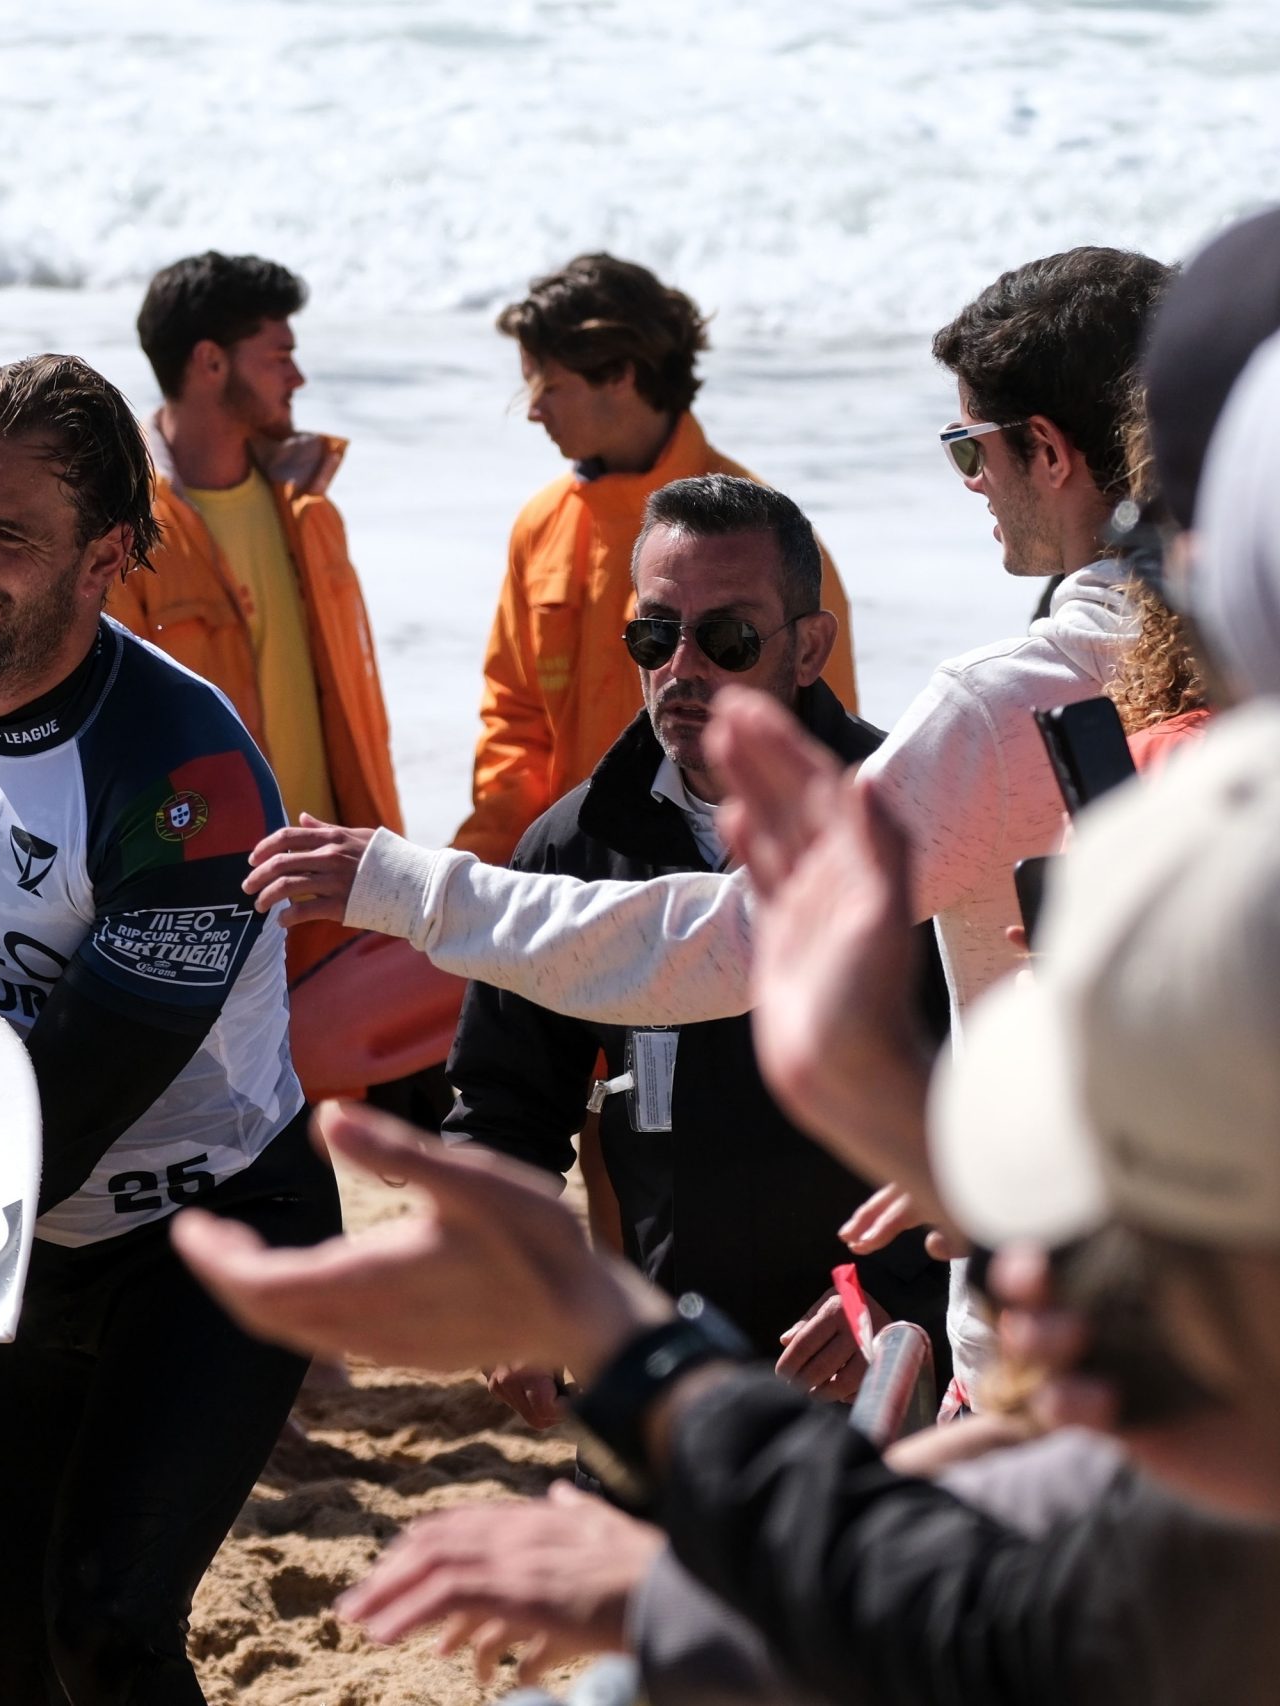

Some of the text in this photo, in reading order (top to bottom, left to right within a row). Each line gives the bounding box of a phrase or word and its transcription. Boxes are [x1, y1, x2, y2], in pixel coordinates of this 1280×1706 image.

[4, 719, 60, 744] LEAGUE
[149, 911, 216, 932] MEO
[117, 924, 231, 943] RIP CURL PRO
[135, 961, 177, 978] Corona
[107, 1151, 216, 1214] 25
